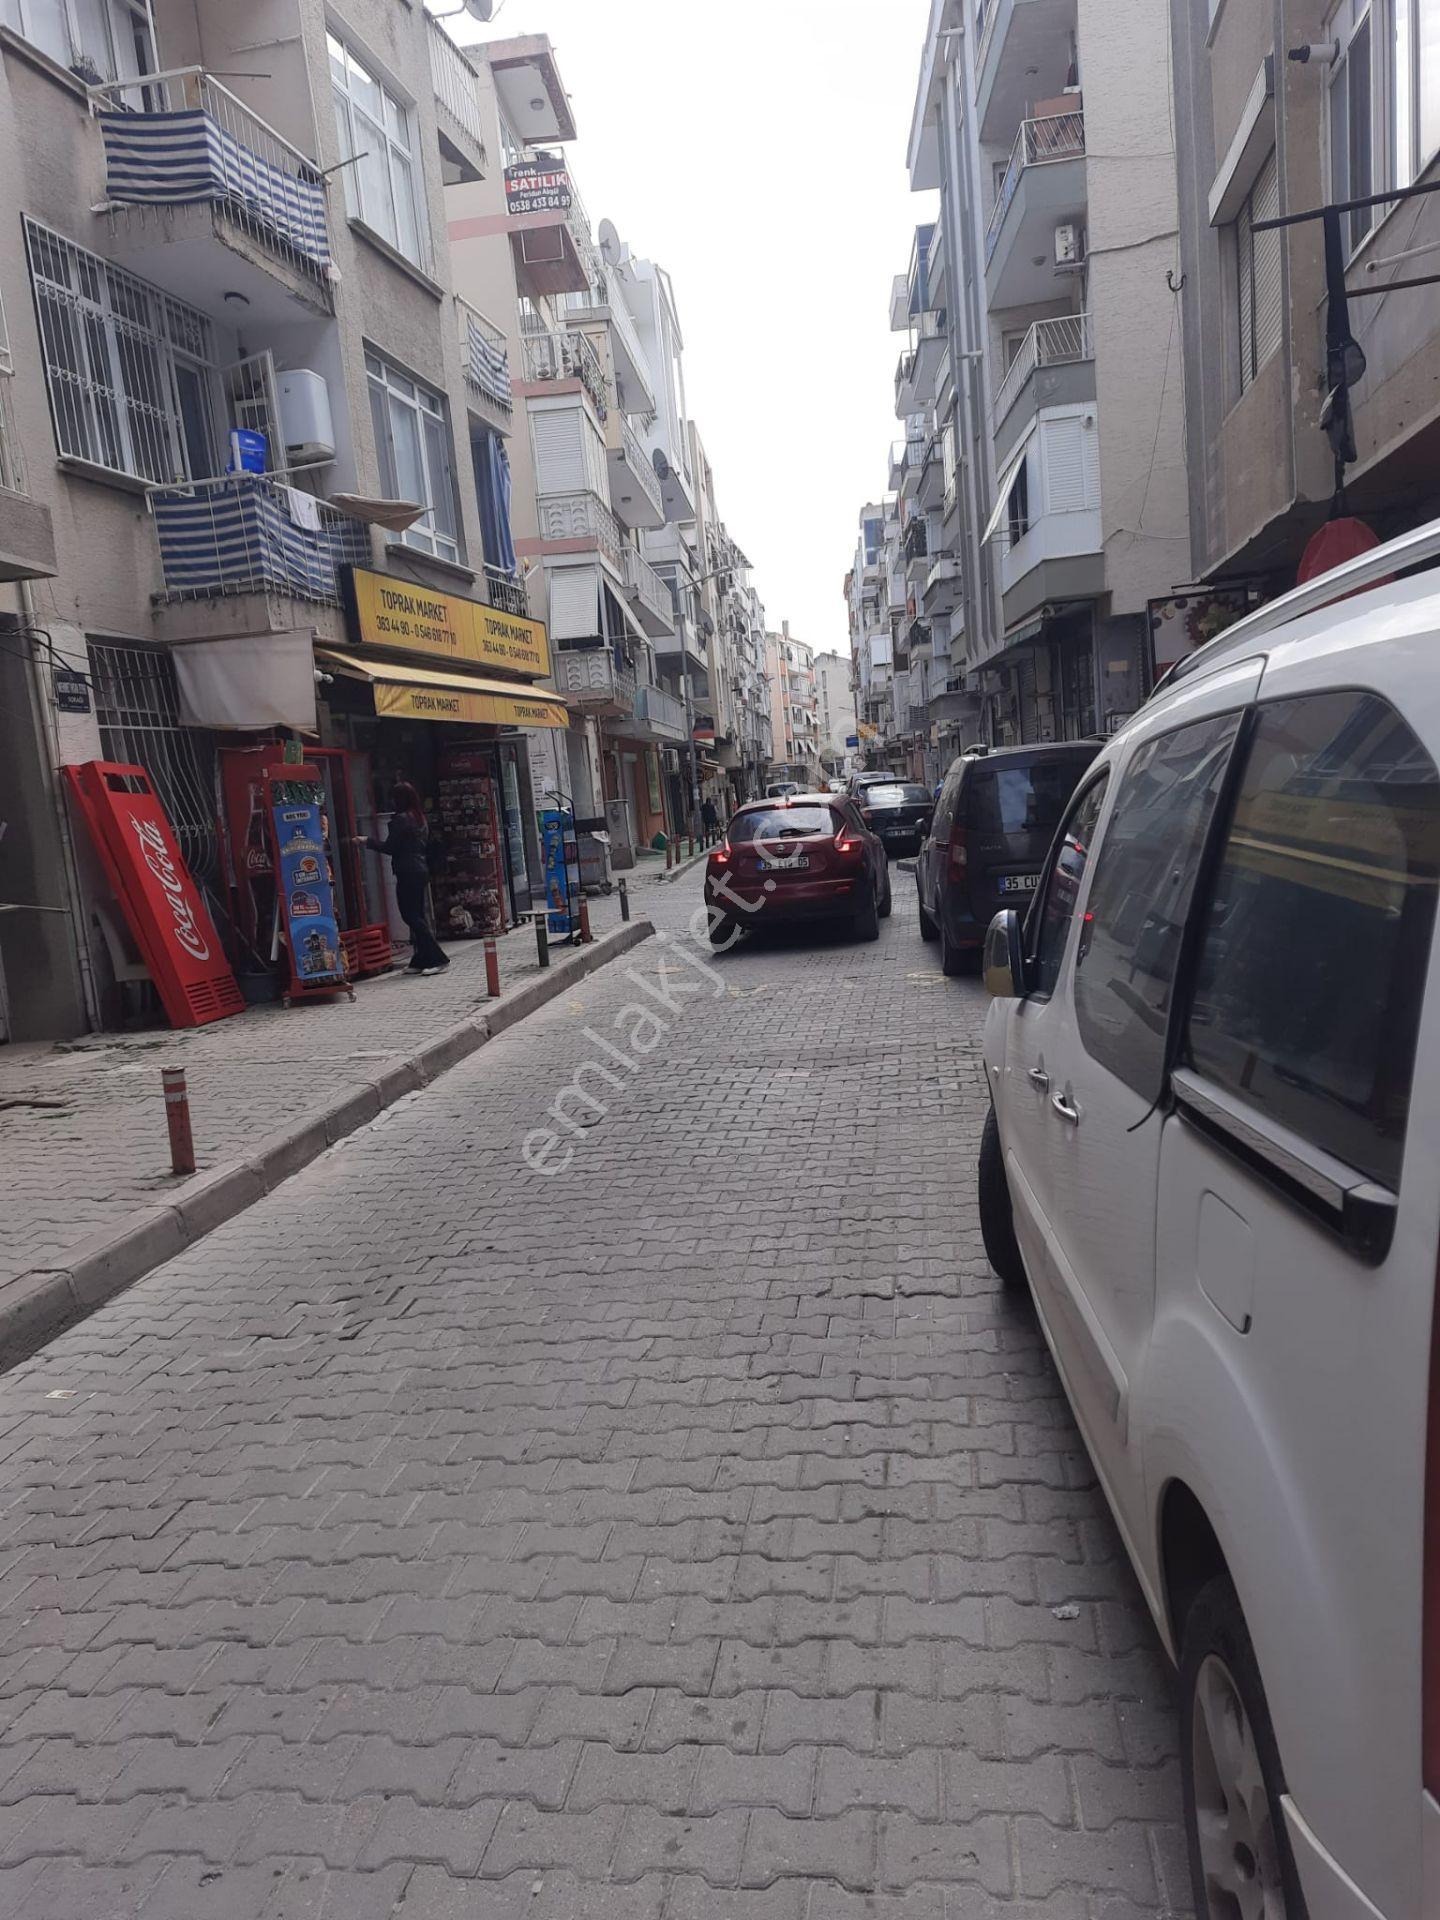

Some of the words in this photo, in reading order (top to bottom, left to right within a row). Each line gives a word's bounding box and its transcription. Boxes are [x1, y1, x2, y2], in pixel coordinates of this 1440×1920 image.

[510, 173, 567, 192] SATILIK
[509, 199, 531, 212] 0538
[531, 196, 547, 209] 433
[547, 195, 560, 207] 84
[380, 588, 416, 616] TOPRAK
[415, 599, 448, 623] MARKET
[376, 615, 391, 632] 363
[391, 618, 400, 633] 44
[399, 620, 410, 636] 90
[484, 617, 511, 640] TOPRAK
[509, 624, 533, 645] MARKET
[411, 694, 437, 711] TOPRAK
[436, 697, 460, 713] MARKET
[513, 704, 533, 718] TOPRAK
[532, 706, 549, 720] MARKET
[127, 810, 211, 961] Coca-Cola
[1005, 876, 1019, 889] 35
[1024, 874, 1041, 888] CU
